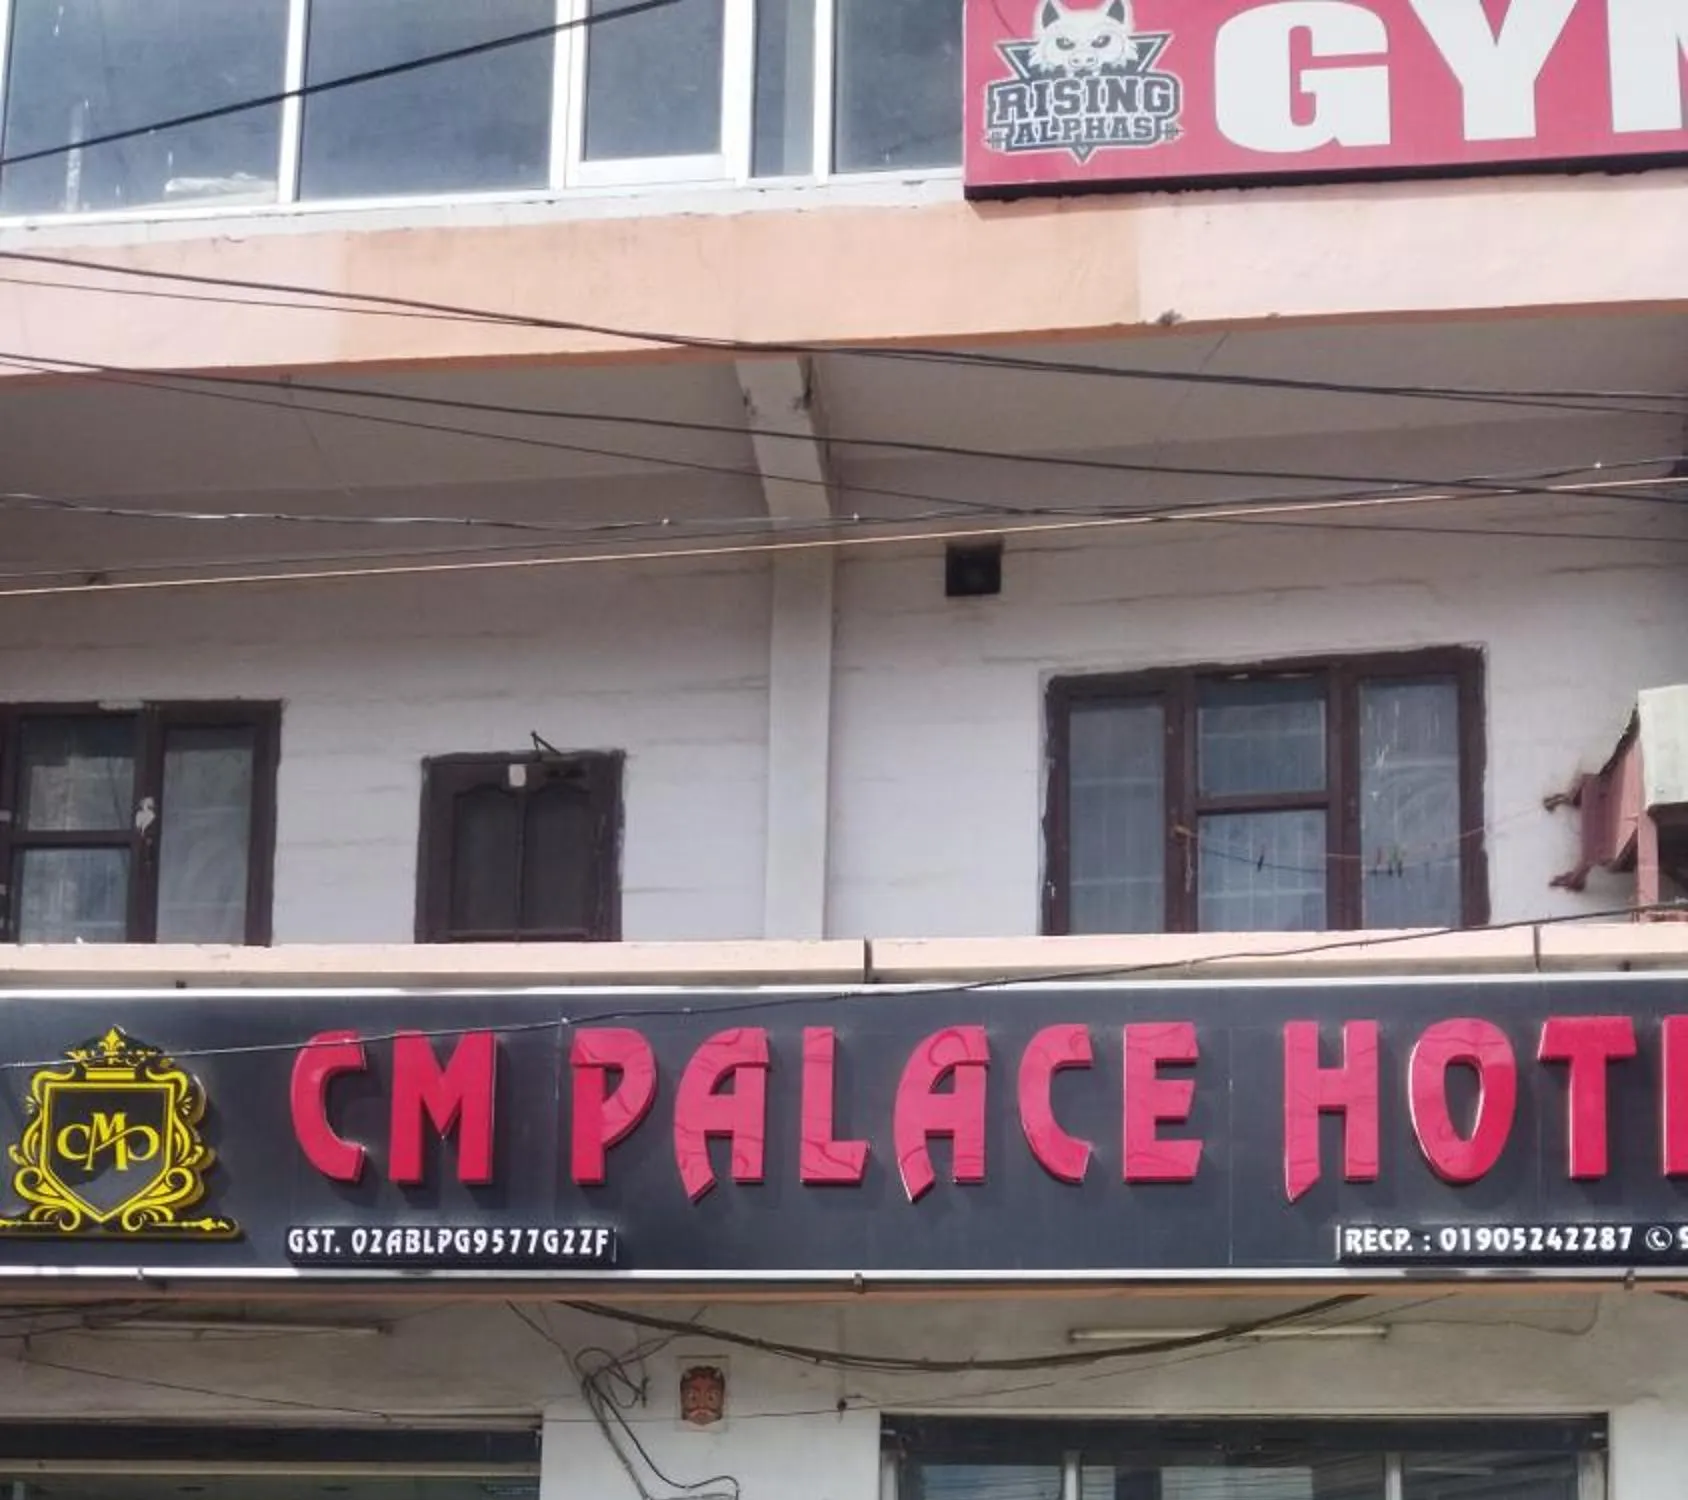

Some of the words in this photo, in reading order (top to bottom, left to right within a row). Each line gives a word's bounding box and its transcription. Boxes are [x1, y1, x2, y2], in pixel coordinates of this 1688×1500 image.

[994, 76, 1174, 122] RISING
[1013, 115, 1155, 146] ALPHAS
[290, 1029, 498, 1183] CM
[569, 1023, 1202, 1201] PALACE
[288, 1228, 342, 1256] GST.
[1345, 1227, 1414, 1254] RECP.
[1440, 1225, 1634, 1252] 01905242287
